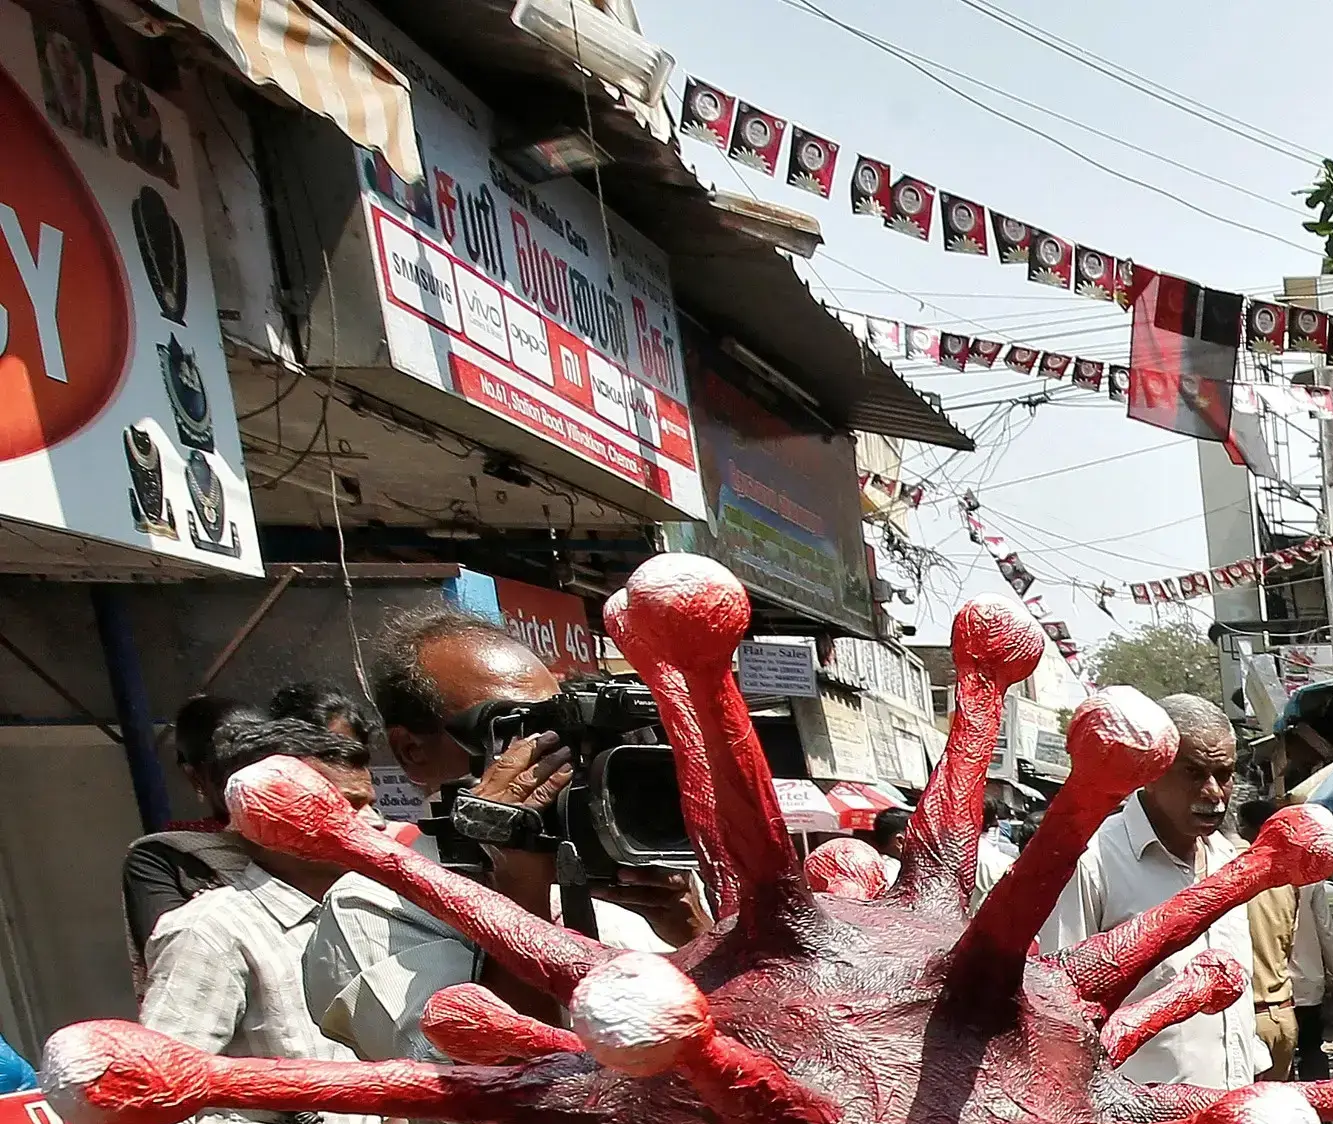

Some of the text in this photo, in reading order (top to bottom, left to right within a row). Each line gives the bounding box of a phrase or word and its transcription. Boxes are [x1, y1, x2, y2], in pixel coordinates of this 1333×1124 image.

[393, 252, 453, 304] SAMSUNG
[463, 289, 502, 328] vivo
[510, 323, 547, 356] oppo
[592, 374, 626, 408] NOKIA
[566, 622, 591, 663] 4G
